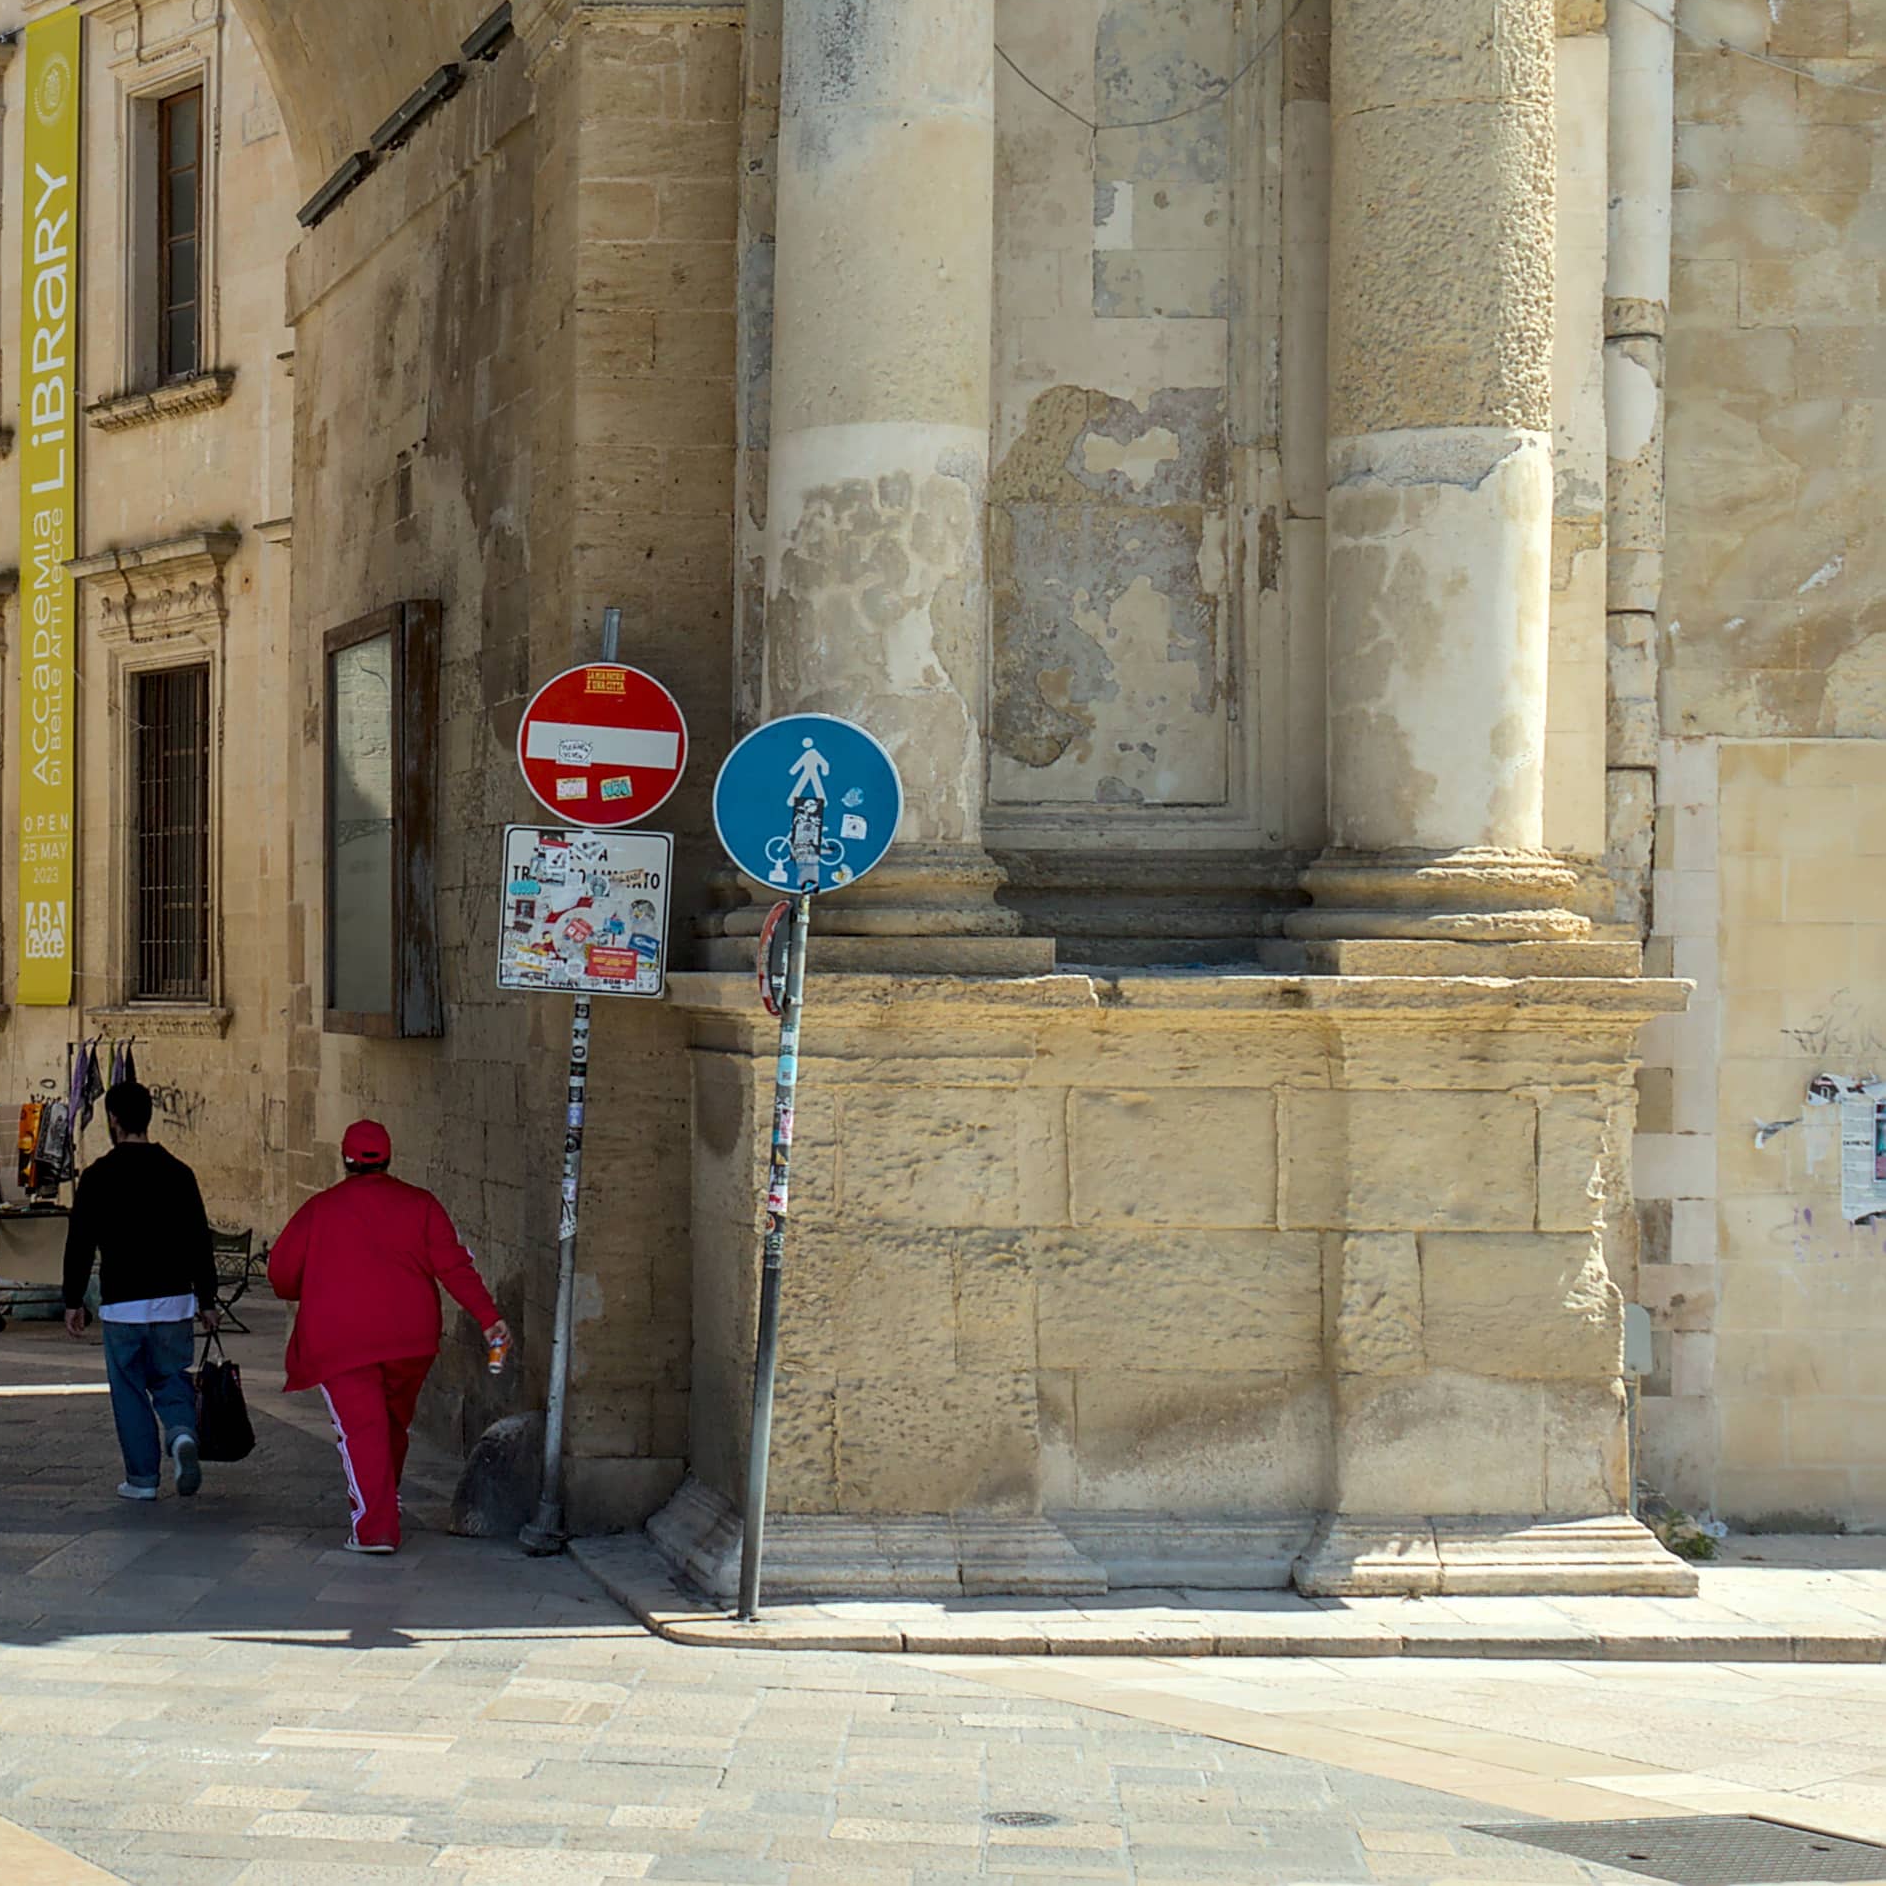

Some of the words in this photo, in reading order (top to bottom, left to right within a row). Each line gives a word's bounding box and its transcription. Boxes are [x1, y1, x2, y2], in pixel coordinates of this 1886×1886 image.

[24, 812, 69, 833] OPEN
[22, 843, 37, 863] 25
[40, 840, 67, 861] MAY
[33, 867, 59, 884] 2023
[26, 900, 65, 941] ABA
